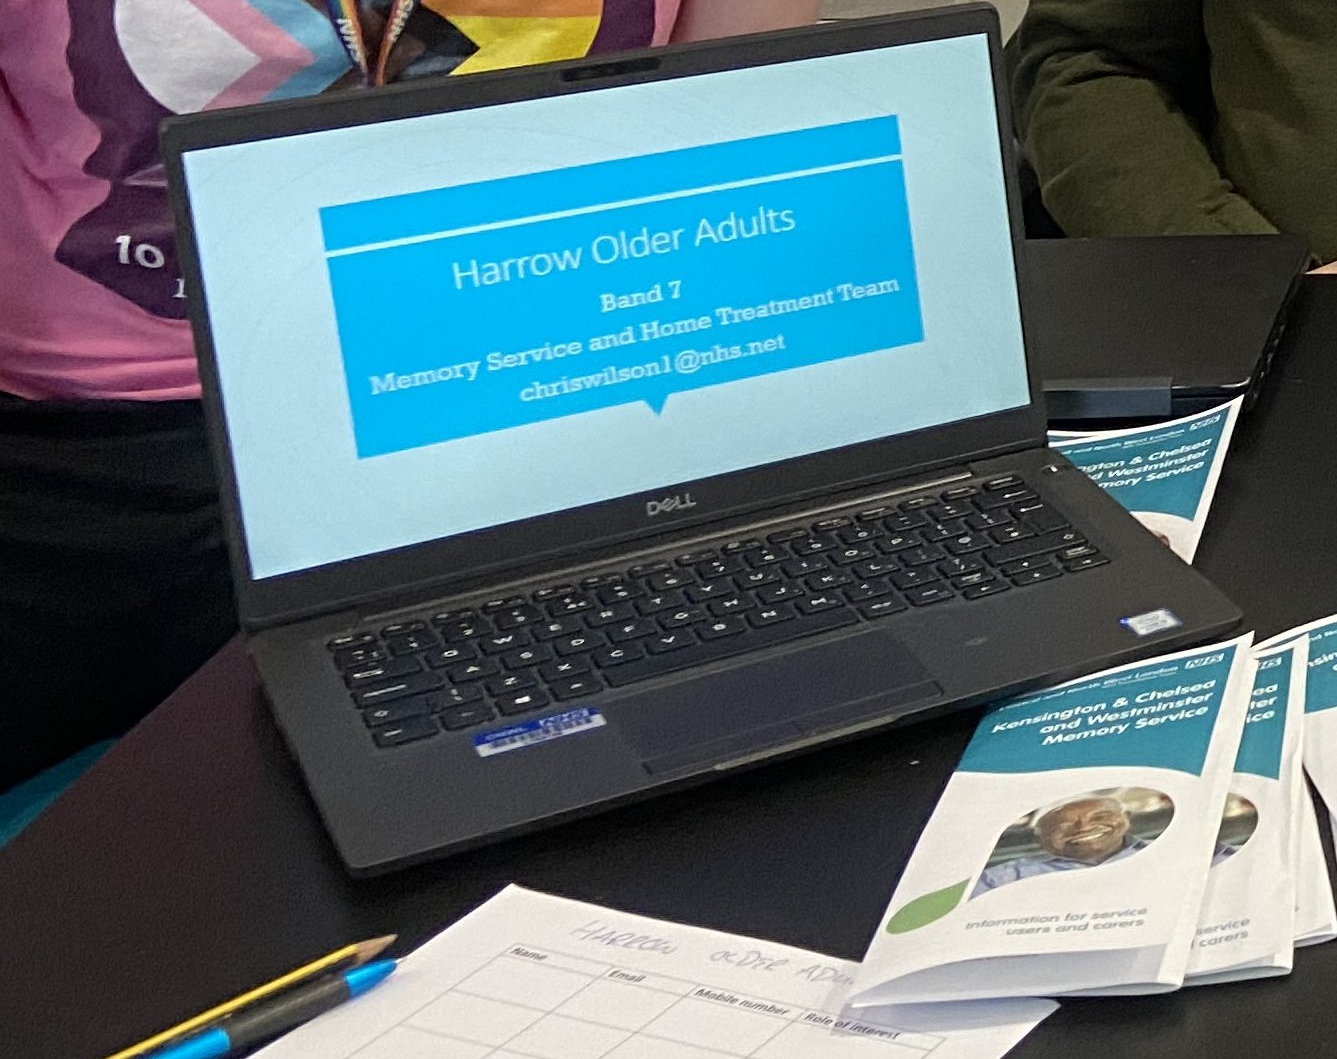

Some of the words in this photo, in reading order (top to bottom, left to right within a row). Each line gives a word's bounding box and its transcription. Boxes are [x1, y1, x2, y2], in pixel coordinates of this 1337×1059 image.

[451, 245, 583, 292] Harrow
[590, 226, 684, 266] Older
[694, 204, 797, 247] Adults
[600, 284, 663, 314] Band
[669, 280, 683, 300] 7
[369, 359, 481, 397] Memory
[486, 340, 583, 372] Service
[589, 326, 635, 352] and
[640, 316, 712, 342] Home
[715, 289, 835, 327] Treatment
[836, 276, 899, 303] Team
[519, 334, 787, 403] chriswilson1@nhs.net
[1077, 460, 1125, 473] ngton
[1129, 456, 1143, 465] &
[1148, 438, 1213, 461] Chelsea
[1108, 449, 1210, 478] Westminster
[1098, 475, 1142, 489] mory
[1145, 461, 1205, 482] Service
[646, 493, 697, 516] DELL
[991, 702, 1107, 734] Kensington
[1112, 697, 1128, 709] &
[1135, 679, 1217, 704] Chelsea
[1039, 719, 1081, 734] and
[1088, 692, 1214, 726] Westminster
[1041, 722, 1131, 746] Memory
[1134, 705, 1209, 729] Service
[965, 913, 1060, 930] Information
[1065, 912, 1086, 922] for
[1091, 907, 1148, 920] service
[1005, 924, 1050, 936] users
[1055, 922, 1089, 933] and
[1092, 918, 1145, 930] carers
[569, 919, 677, 955] HARROW
[510, 946, 548, 961] Name
[608, 970, 647, 983] Email
[694, 988, 739, 1005] Mobile
[739, 998, 790, 1016] number
[803, 1012, 834, 1026] Role
[834, 1019, 852, 1029] of
[849, 1021, 901, 1040] interest
